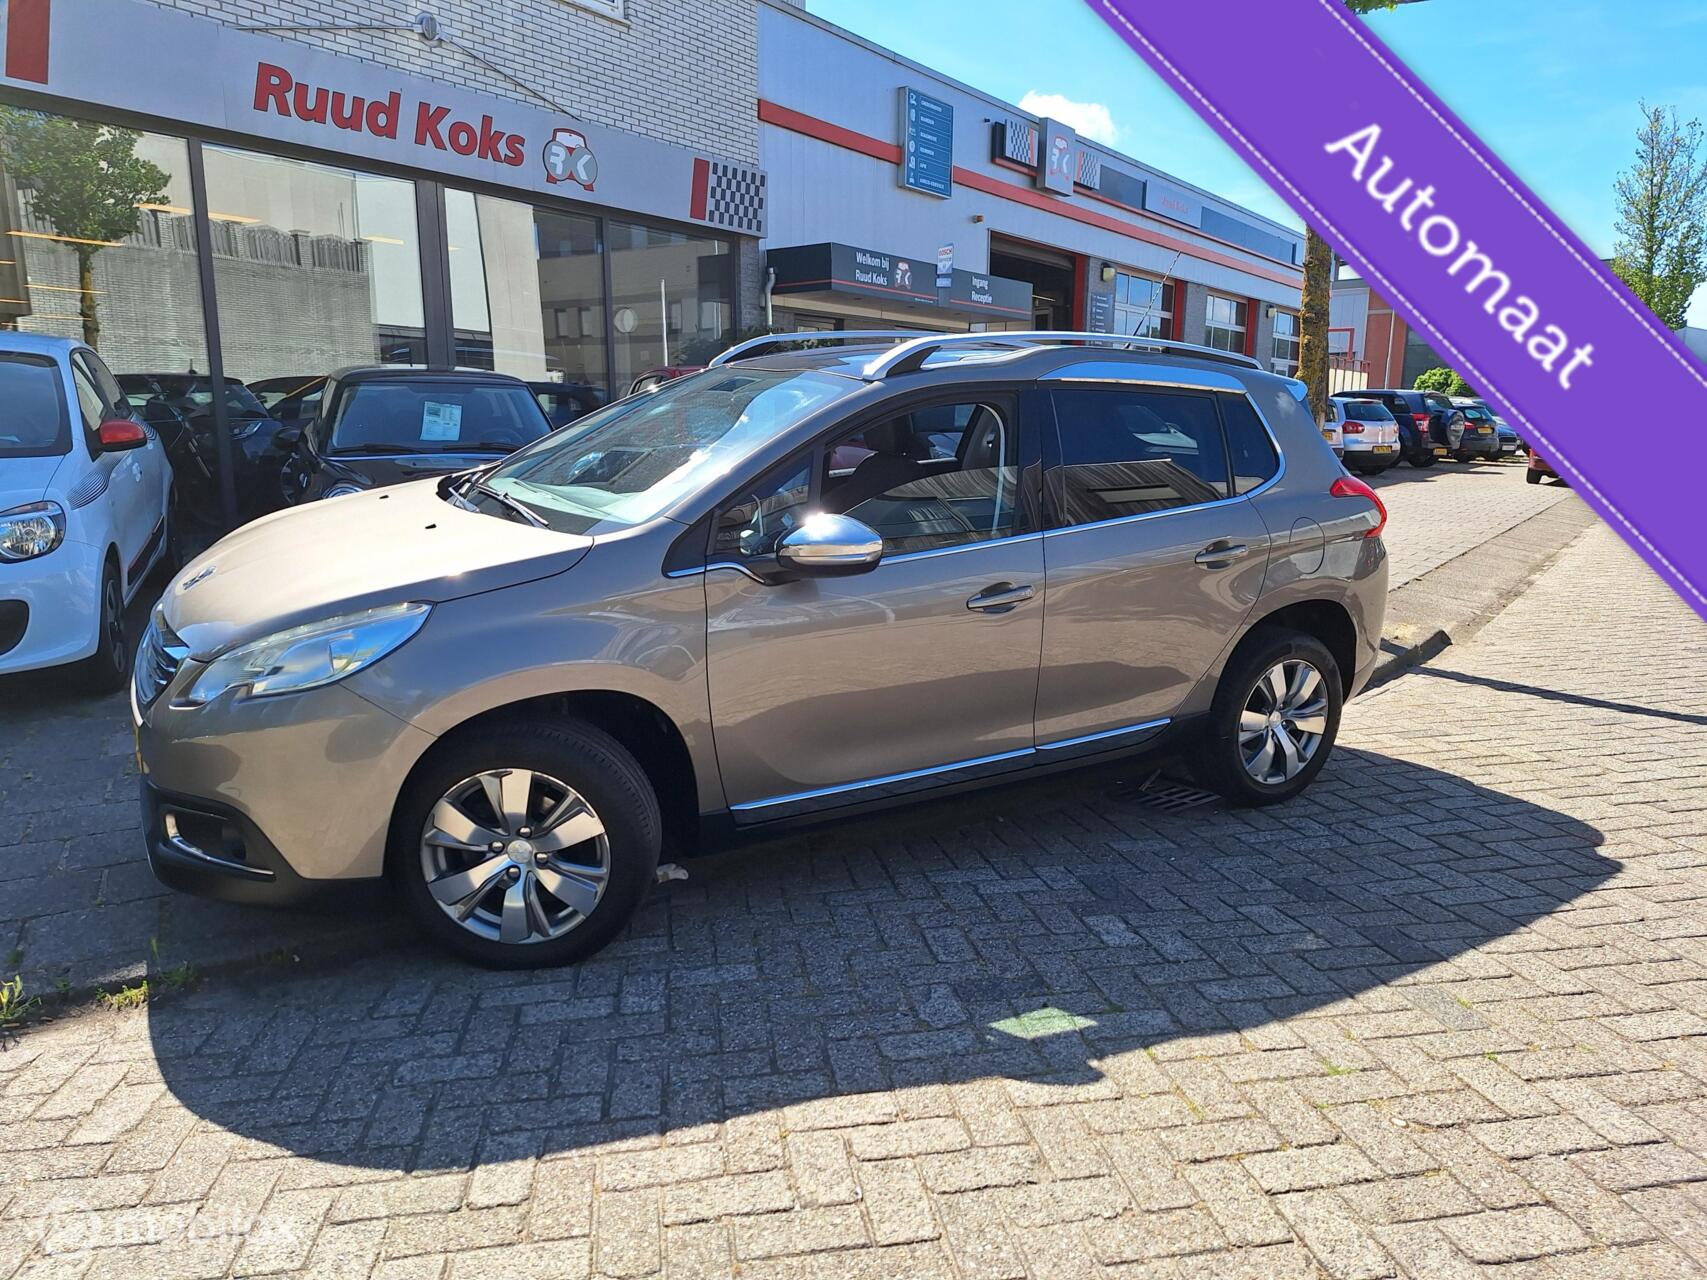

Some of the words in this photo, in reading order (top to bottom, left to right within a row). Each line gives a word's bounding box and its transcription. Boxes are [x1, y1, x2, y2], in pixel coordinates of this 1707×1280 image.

[253, 61, 401, 139] Ruud
[414, 101, 525, 167] Koks
[856, 251, 881, 267] Welkom
[881, 257, 890, 271] bij
[855, 269, 872, 283] Ruud
[872, 273, 887, 286] Koks
[972, 275, 988, 290] Ingang
[971, 291, 992, 304] Receptie
